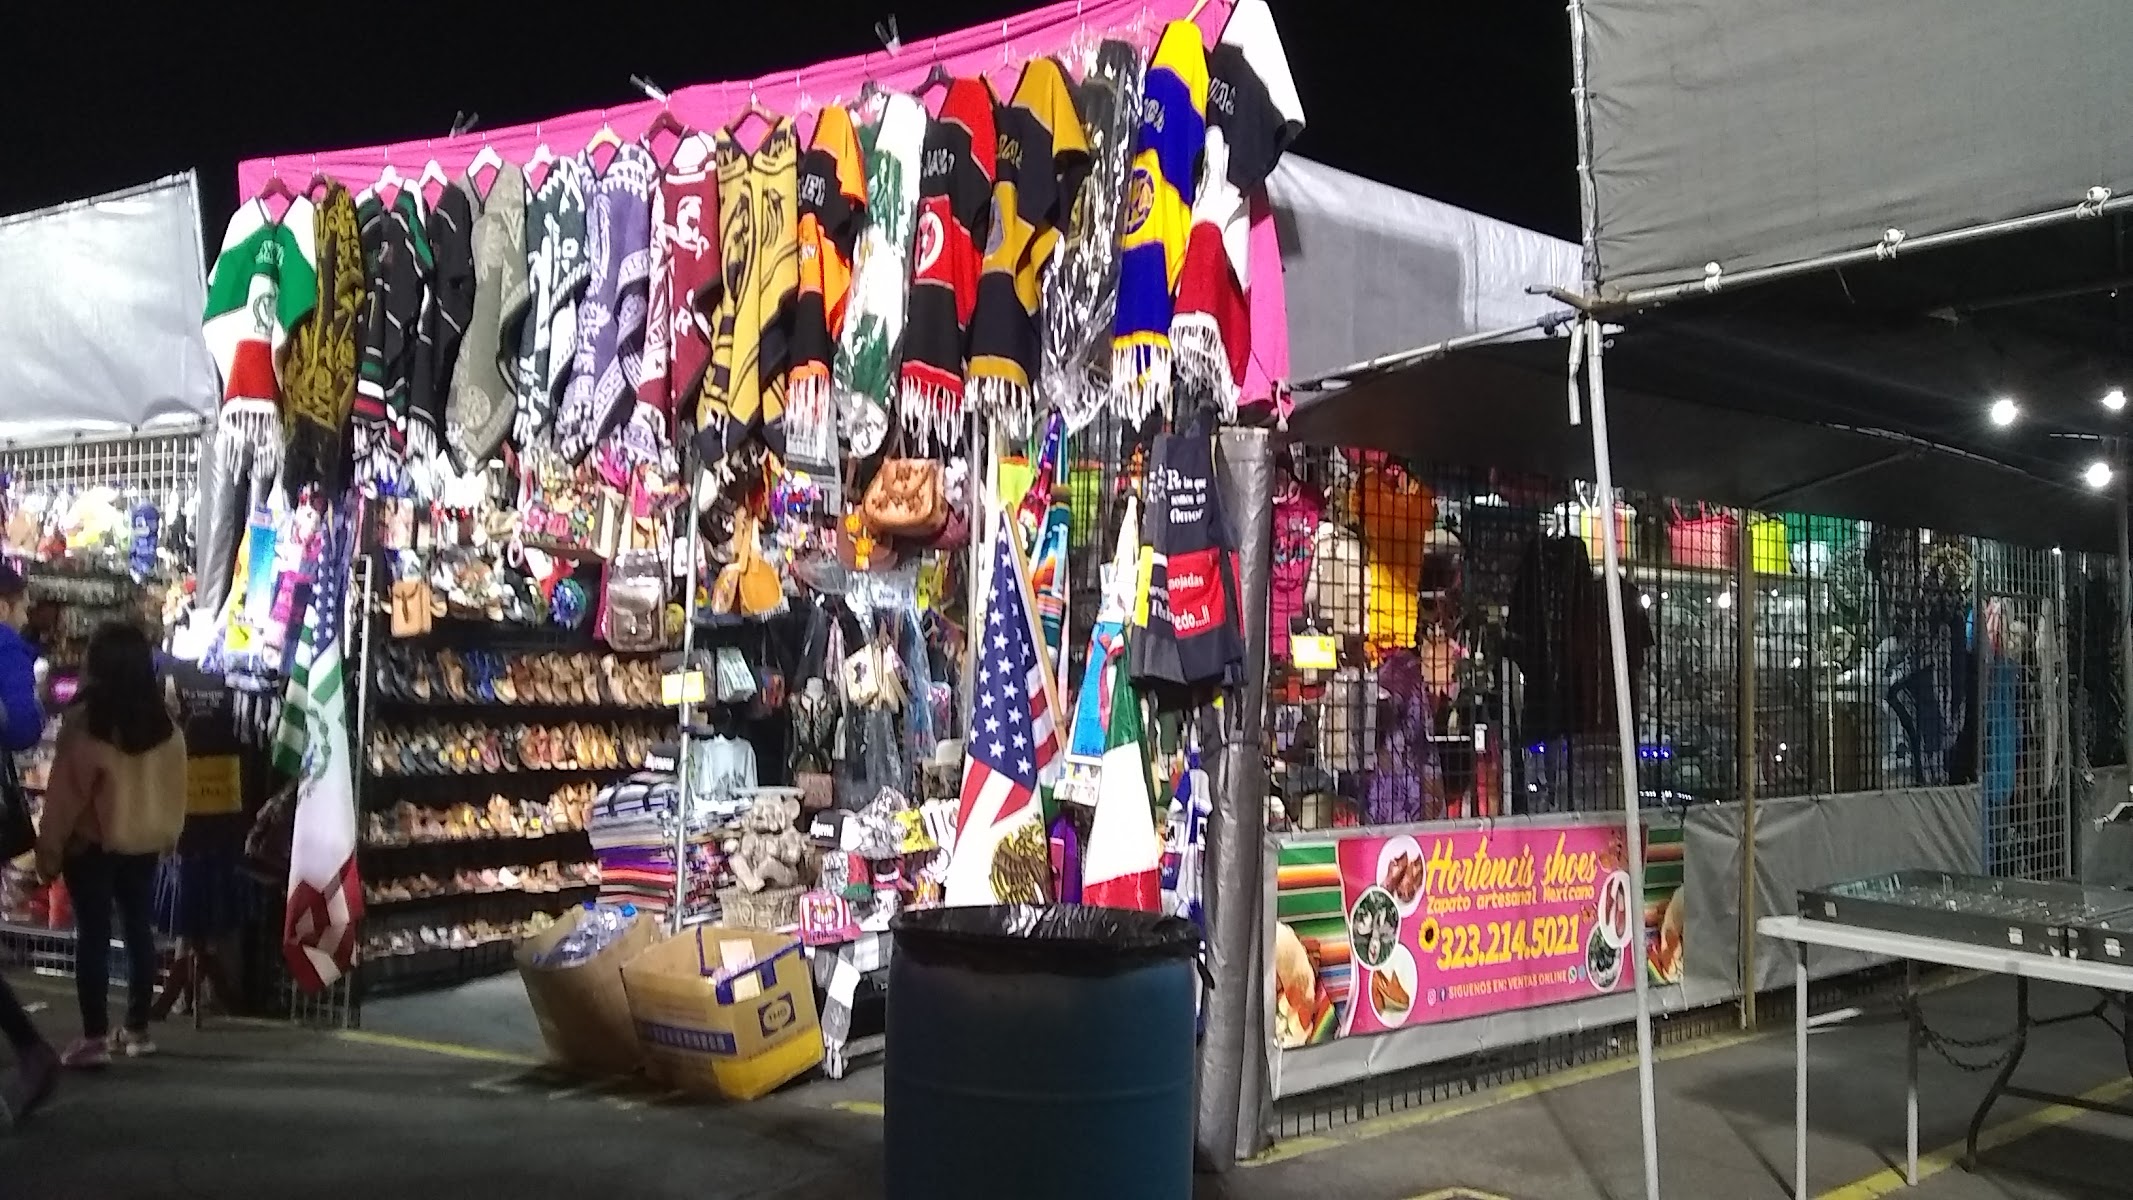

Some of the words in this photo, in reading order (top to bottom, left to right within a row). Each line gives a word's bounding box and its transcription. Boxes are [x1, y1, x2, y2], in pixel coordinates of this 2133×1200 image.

[1541, 831, 1597, 886] shoes
[1477, 886, 1537, 910] artesanal
[1543, 883, 1595, 903] Mexicano
[1437, 914, 1580, 971] 323.214.5021
[1449, 981, 1492, 999] SIGUENOS
[1508, 974, 1538, 989] VENTAS
[1539, 970, 1567, 985] ONLINE
